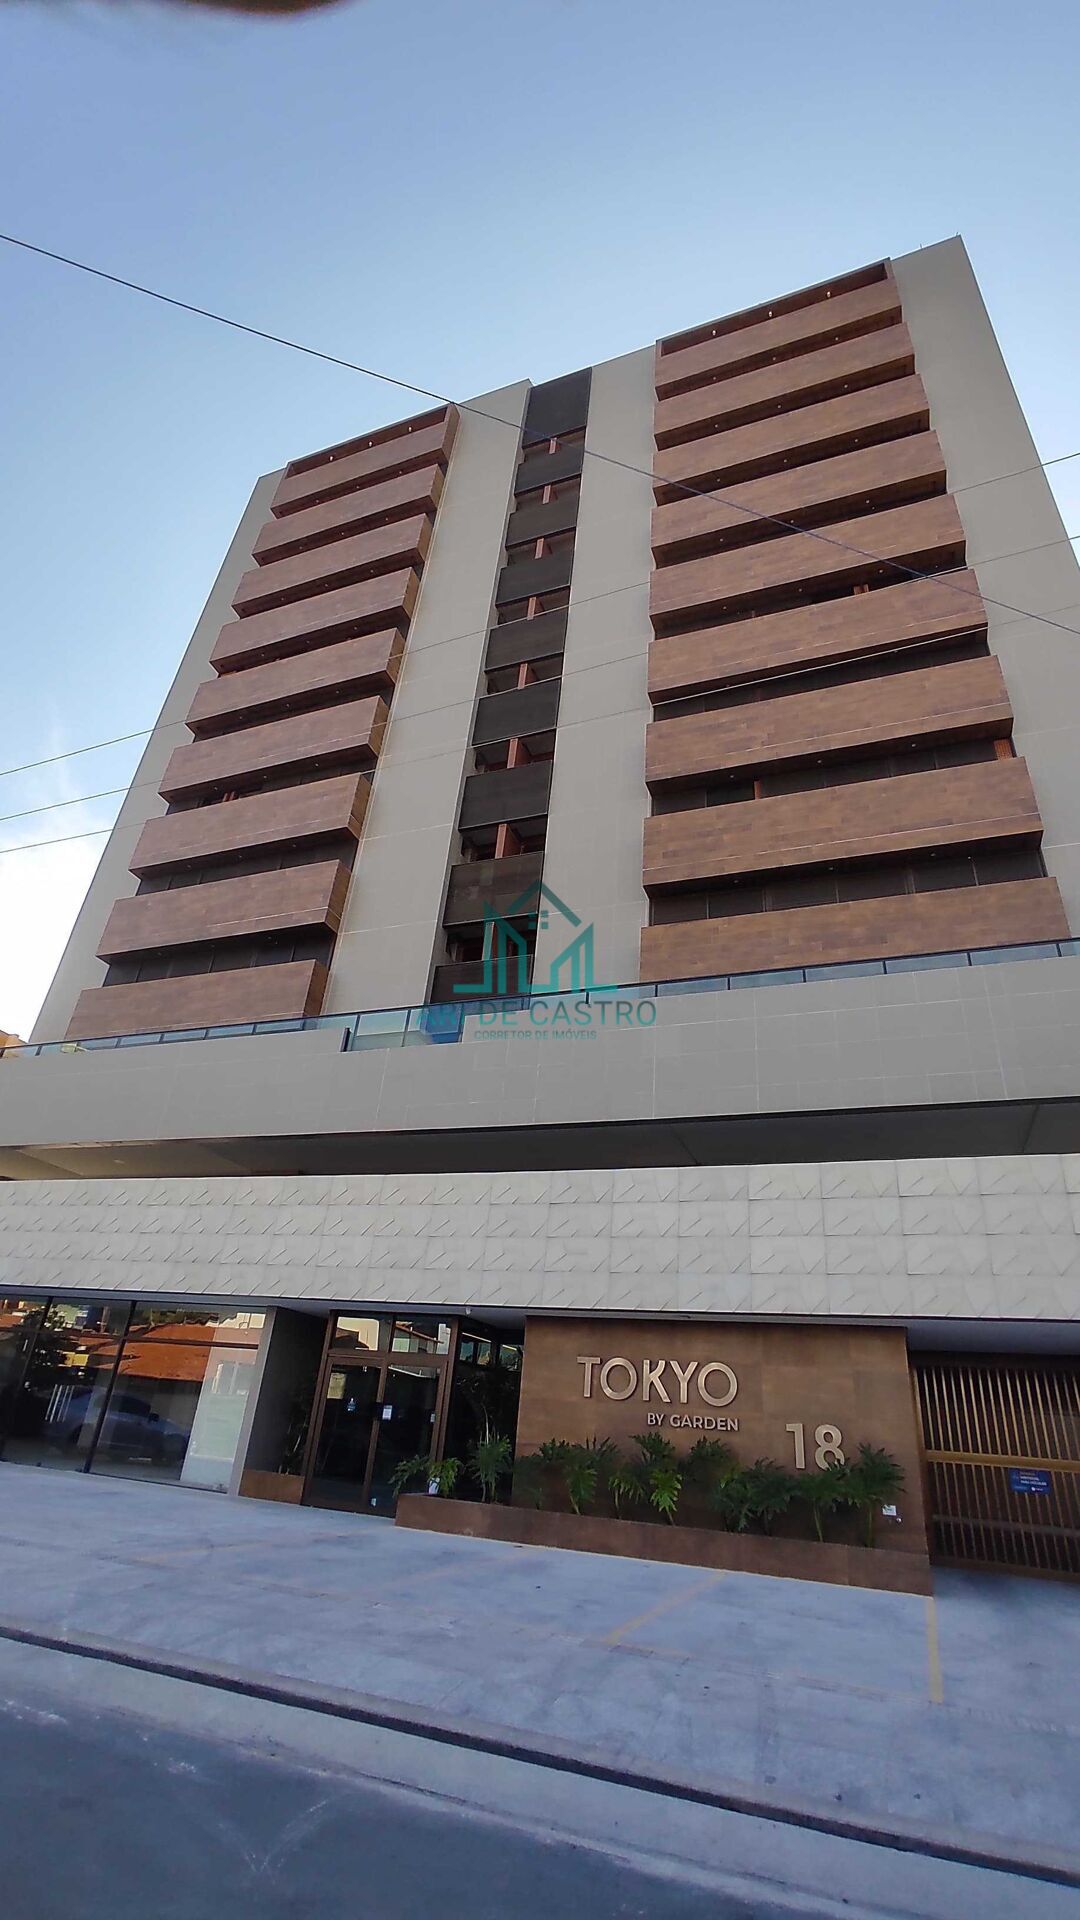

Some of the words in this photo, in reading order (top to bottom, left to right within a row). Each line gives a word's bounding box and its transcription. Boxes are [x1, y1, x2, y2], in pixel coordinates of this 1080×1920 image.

[577, 1356, 738, 1407] TOKYO
[647, 1412, 664, 1426] BY
[669, 1414, 739, 1431] GARDEN
[785, 1423, 846, 1471] 18
